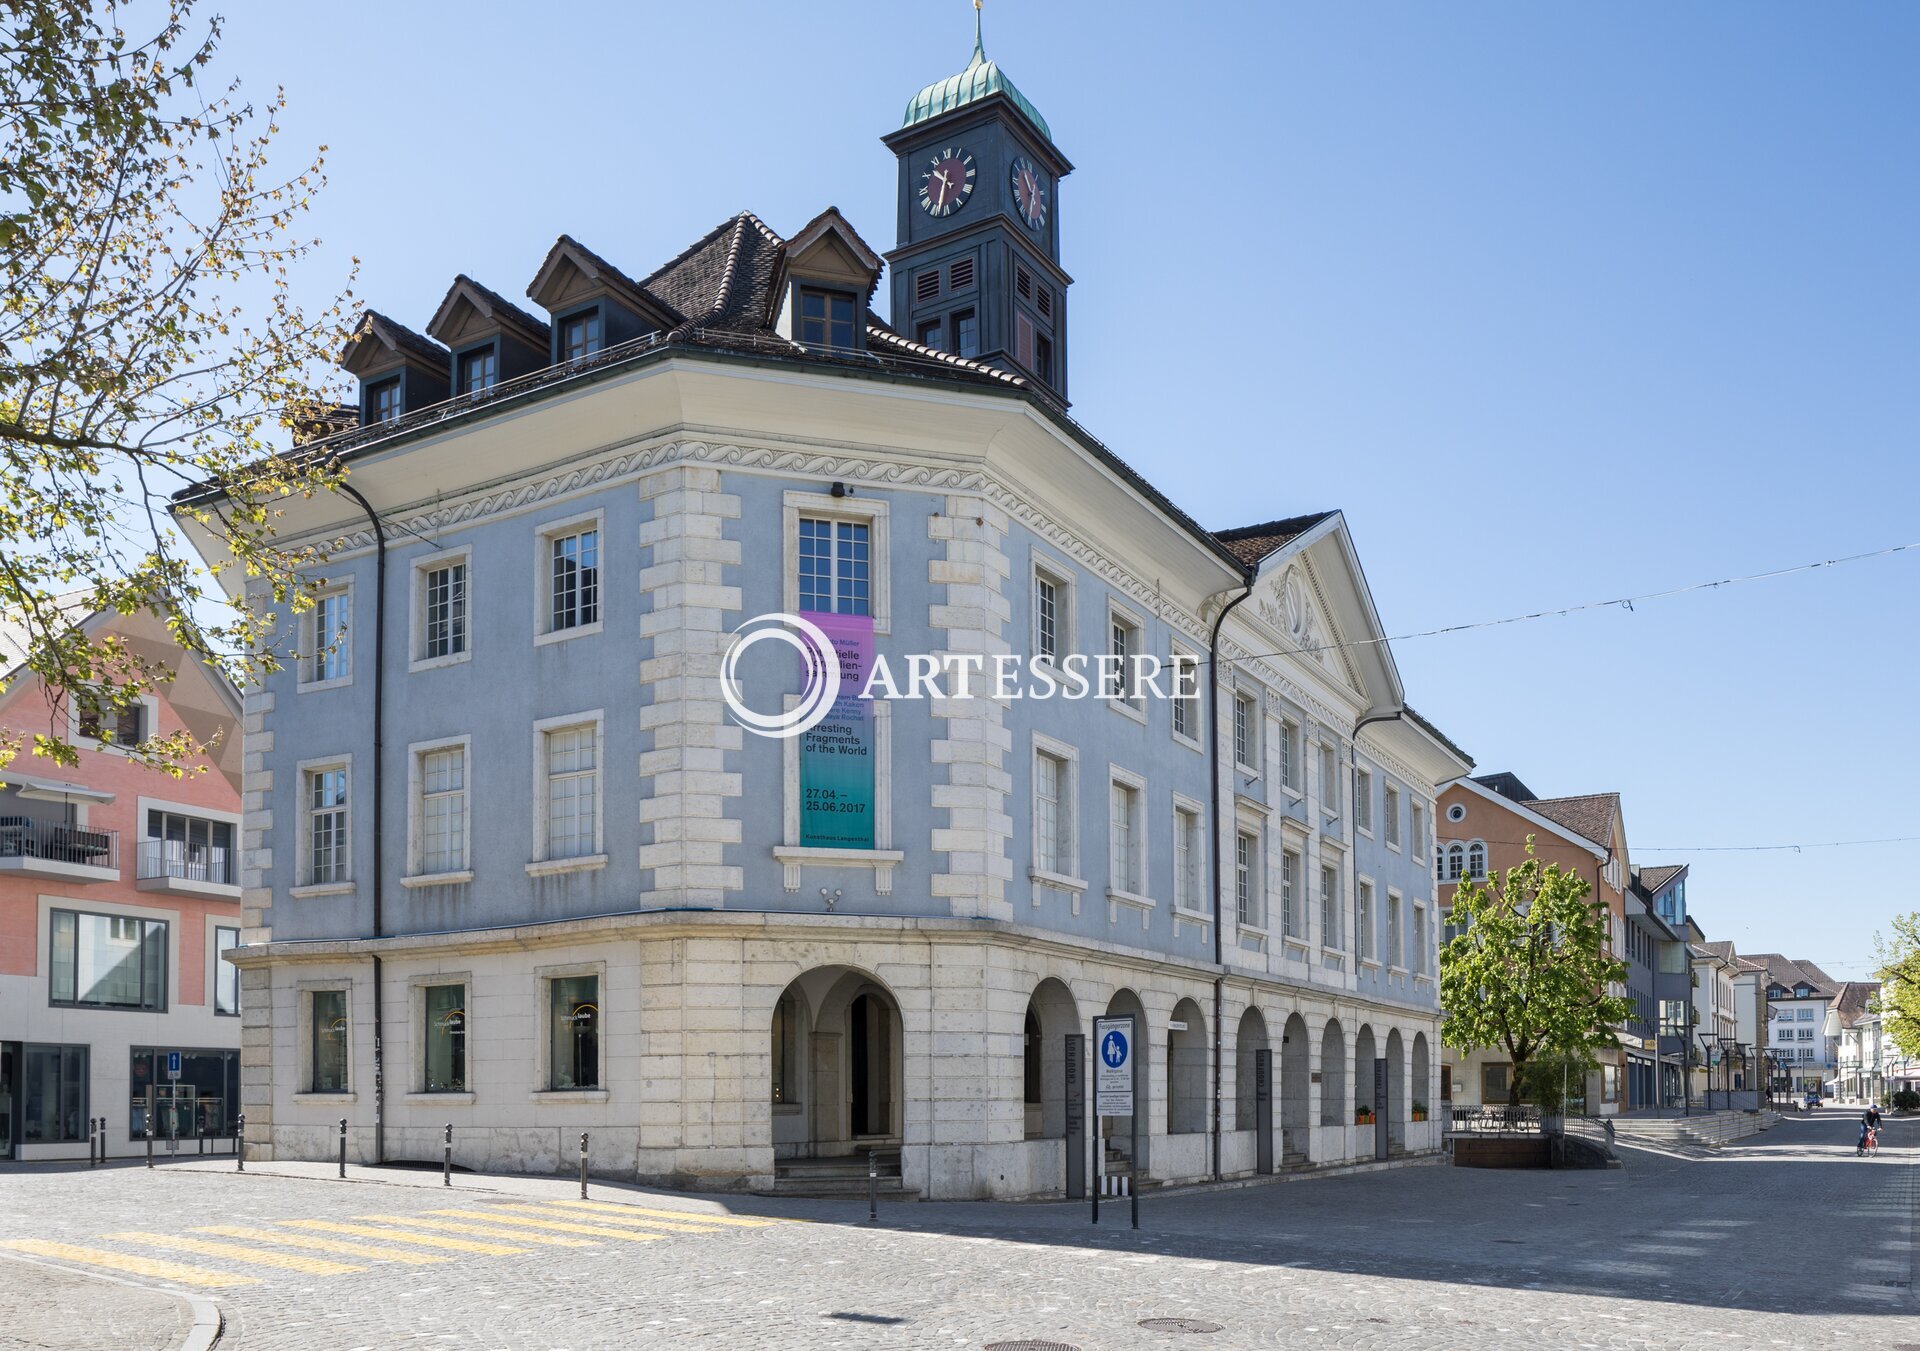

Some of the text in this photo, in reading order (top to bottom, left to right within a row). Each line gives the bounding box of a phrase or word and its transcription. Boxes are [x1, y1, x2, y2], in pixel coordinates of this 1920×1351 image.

[806, 732, 860, 745] Fragments
[805, 743, 867, 756] of the World
[806, 788, 839, 800] 27.04.
[806, 800, 866, 813] 25.06.2017
[806, 833, 836, 841] Kunsthaus
